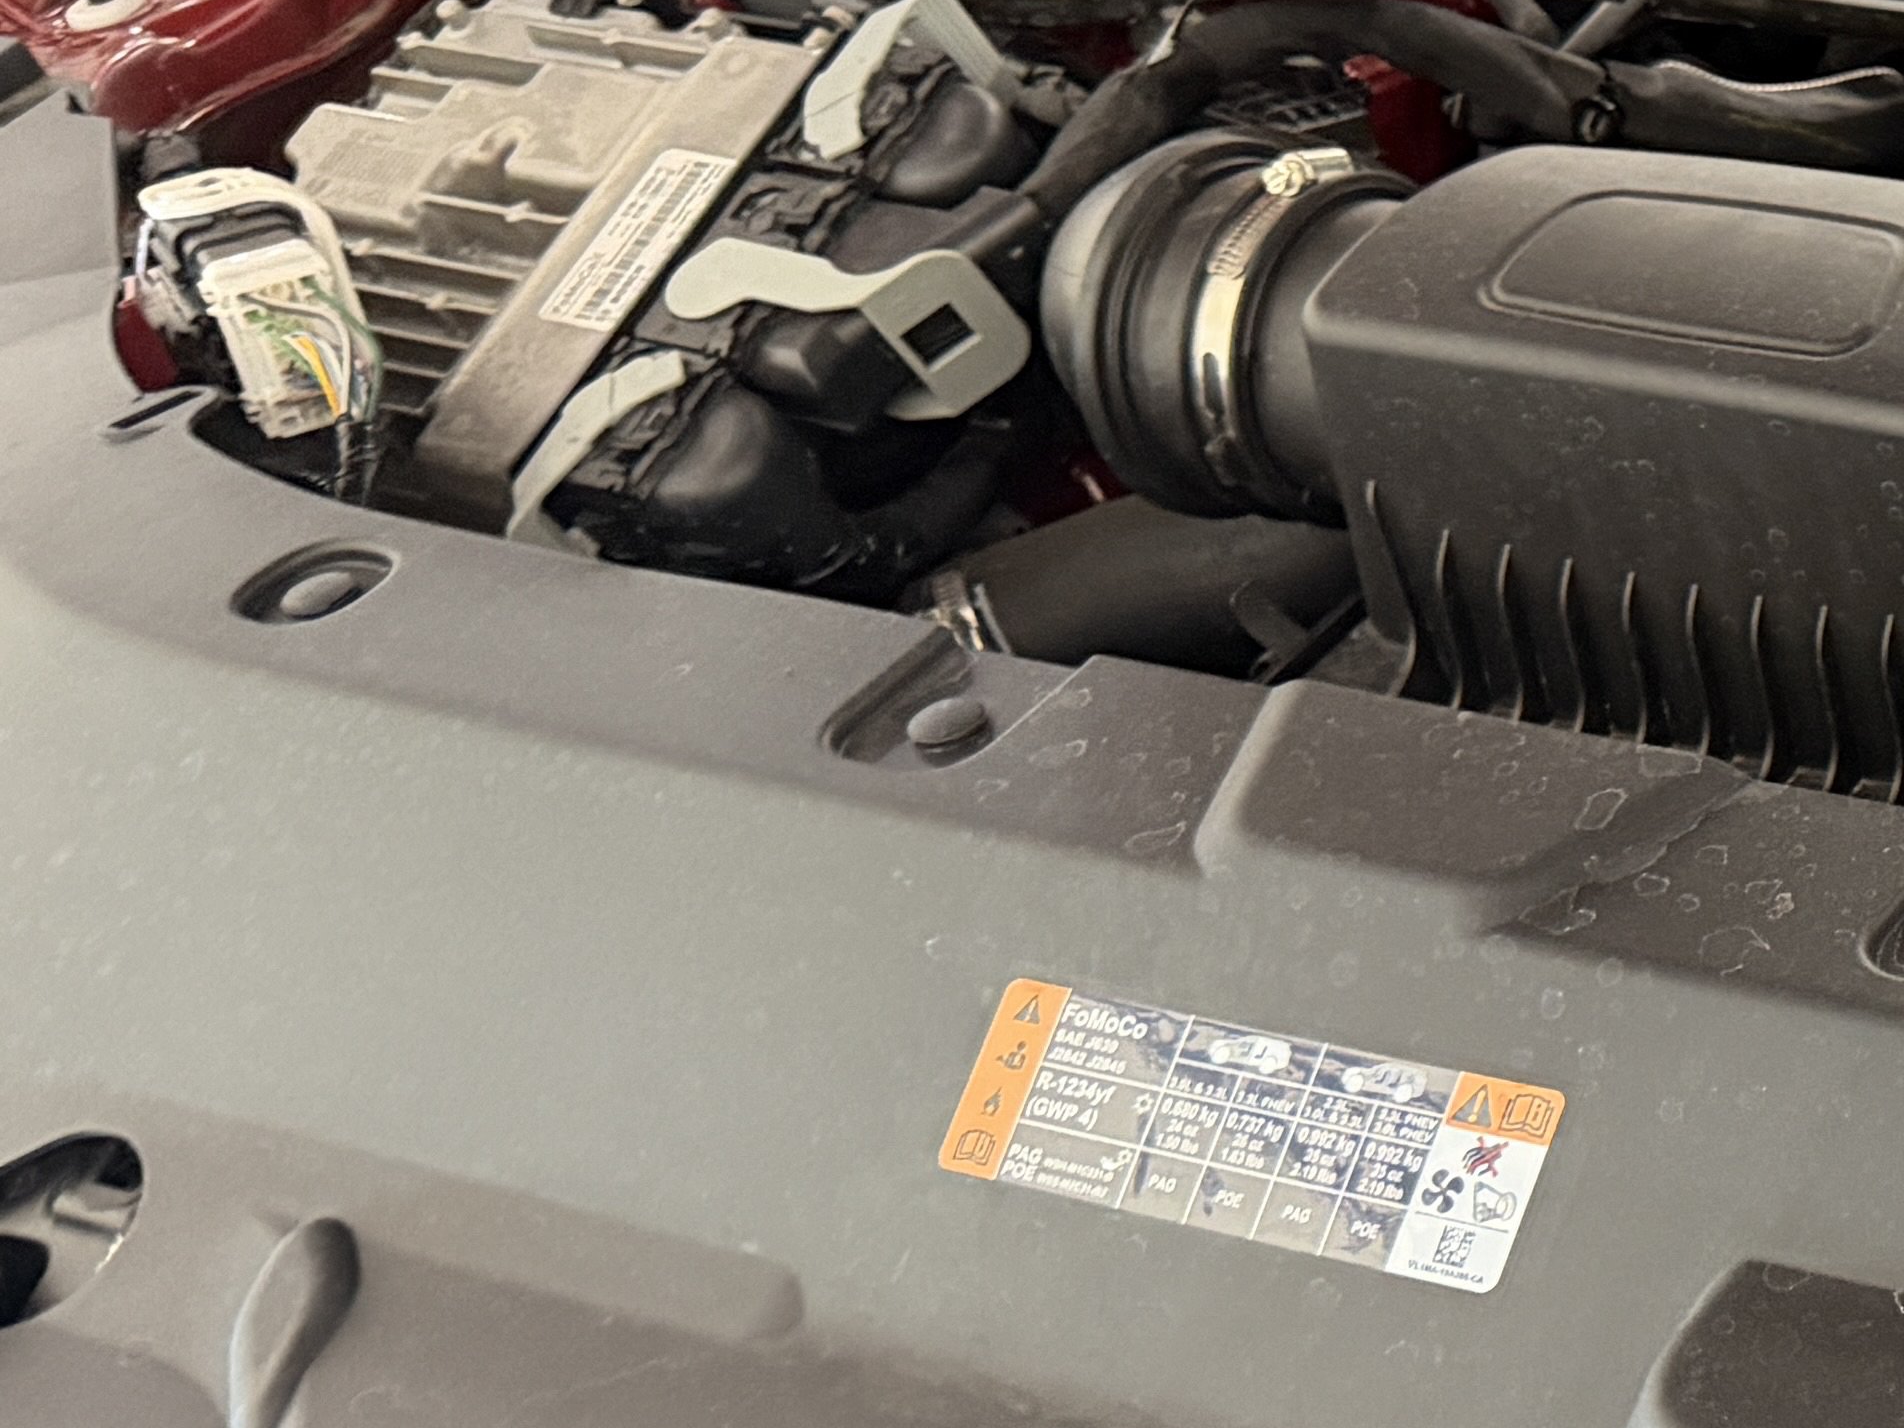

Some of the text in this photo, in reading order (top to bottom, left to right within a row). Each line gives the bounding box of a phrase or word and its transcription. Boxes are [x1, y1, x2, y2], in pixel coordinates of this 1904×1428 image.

[1062, 1004, 1148, 1039] FoMoCo
[1055, 1028, 1086, 1047] SAE
[1036, 1072, 1114, 1105] R-1234yf
[1025, 1096, 1099, 1131] (GWP 4)
[1161, 1098, 1219, 1129] 0.680 kg
[1404, 1113, 1439, 1130] PHEV
[1166, 1118, 1200, 1137] 24 oz
[1226, 1112, 1285, 1143] 0.737 kg
[1399, 1127, 1433, 1143] PHEV
[1179, 1138, 1199, 1155] lbs
[1248, 1139, 1265, 1152] oz
[1298, 1127, 1356, 1158] 0.992 kg
[1008, 1143, 1043, 1165] PAG
[1245, 1153, 1265, 1169] lbs
[1303, 1147, 1337, 1167] 35 oz
[1364, 1142, 1423, 1173] 0.992 kg
[1000, 1160, 1038, 1182] POE
[1289, 1162, 1337, 1185] 2.19 lbs
[1369, 1162, 1404, 1183] 35 oz
[1146, 1174, 1177, 1193] PAG
[1356, 1177, 1404, 1200] 2.19 lbs
[1213, 1189, 1244, 1209] POE
[1280, 1205, 1312, 1224] PAG
[1350, 1220, 1380, 1240] POE
